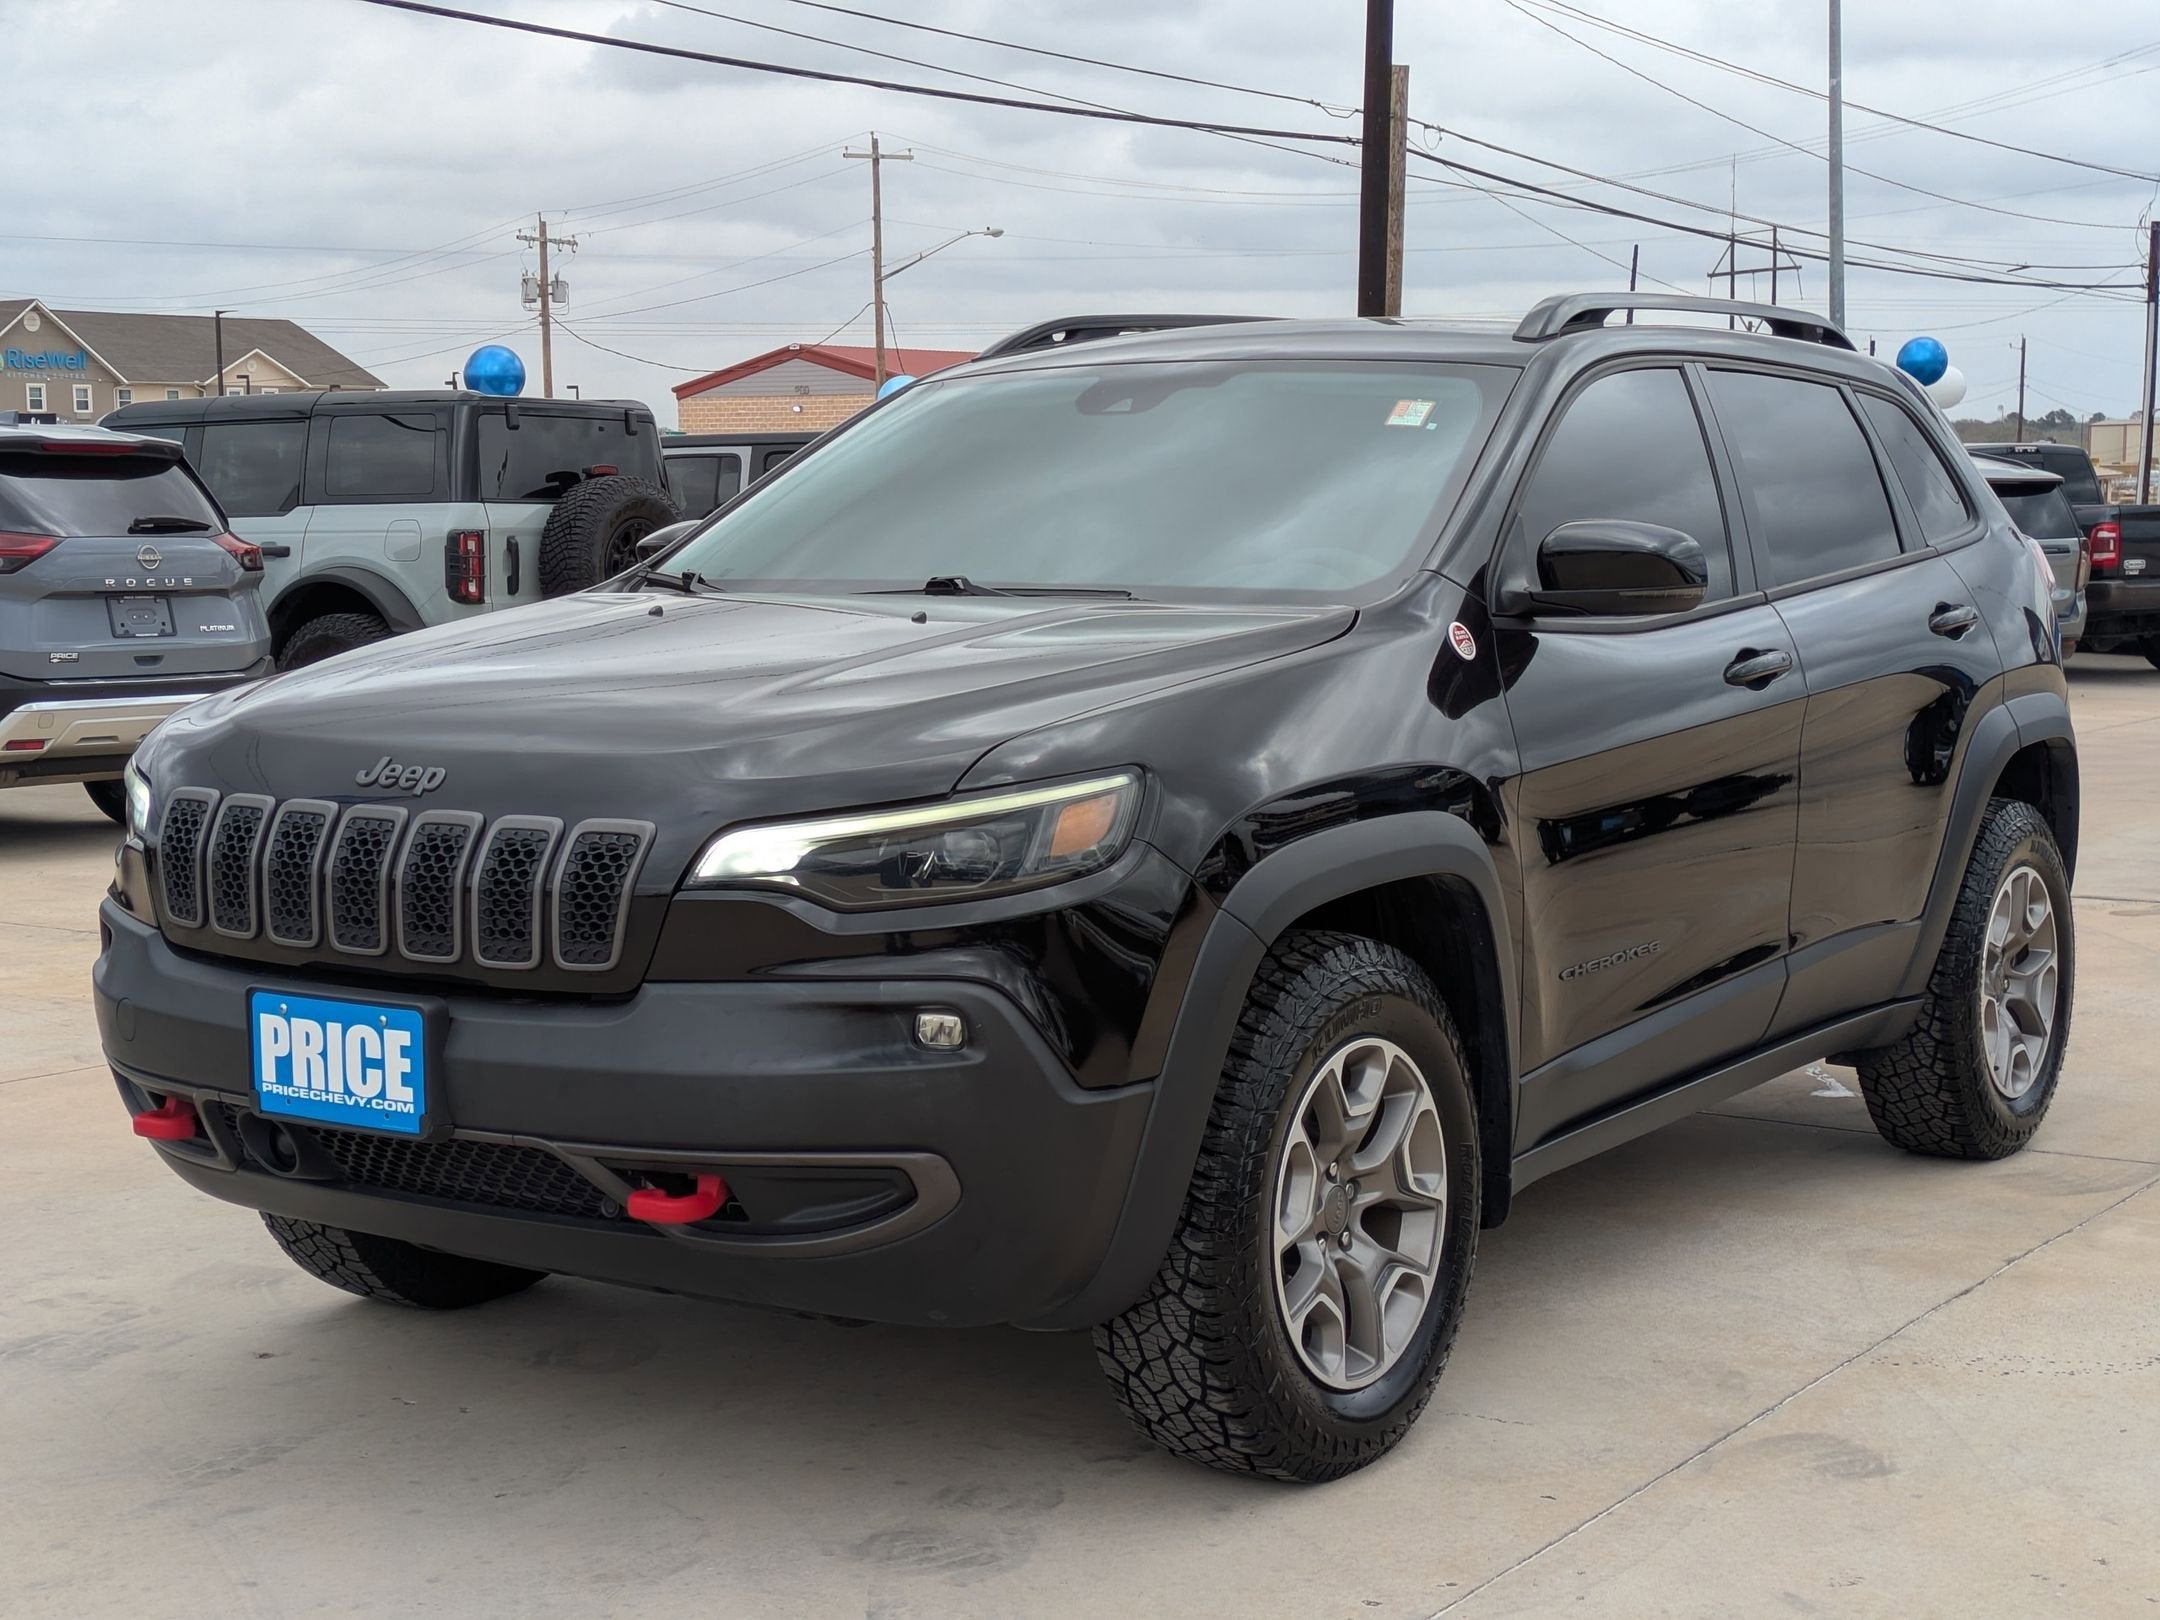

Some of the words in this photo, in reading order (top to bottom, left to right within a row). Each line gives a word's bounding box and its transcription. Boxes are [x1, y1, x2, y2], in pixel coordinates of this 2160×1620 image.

[6, 348, 87, 370] RiseWell
[105, 577, 193, 588] ROGUE
[199, 624, 235, 632] PLATINUM
[355, 755, 447, 798] Jeep
[1558, 940, 1662, 982] CHEROKEE
[259, 1012, 414, 1103] PRICE
[262, 1081, 415, 1115] PRICECHEVY.COM
